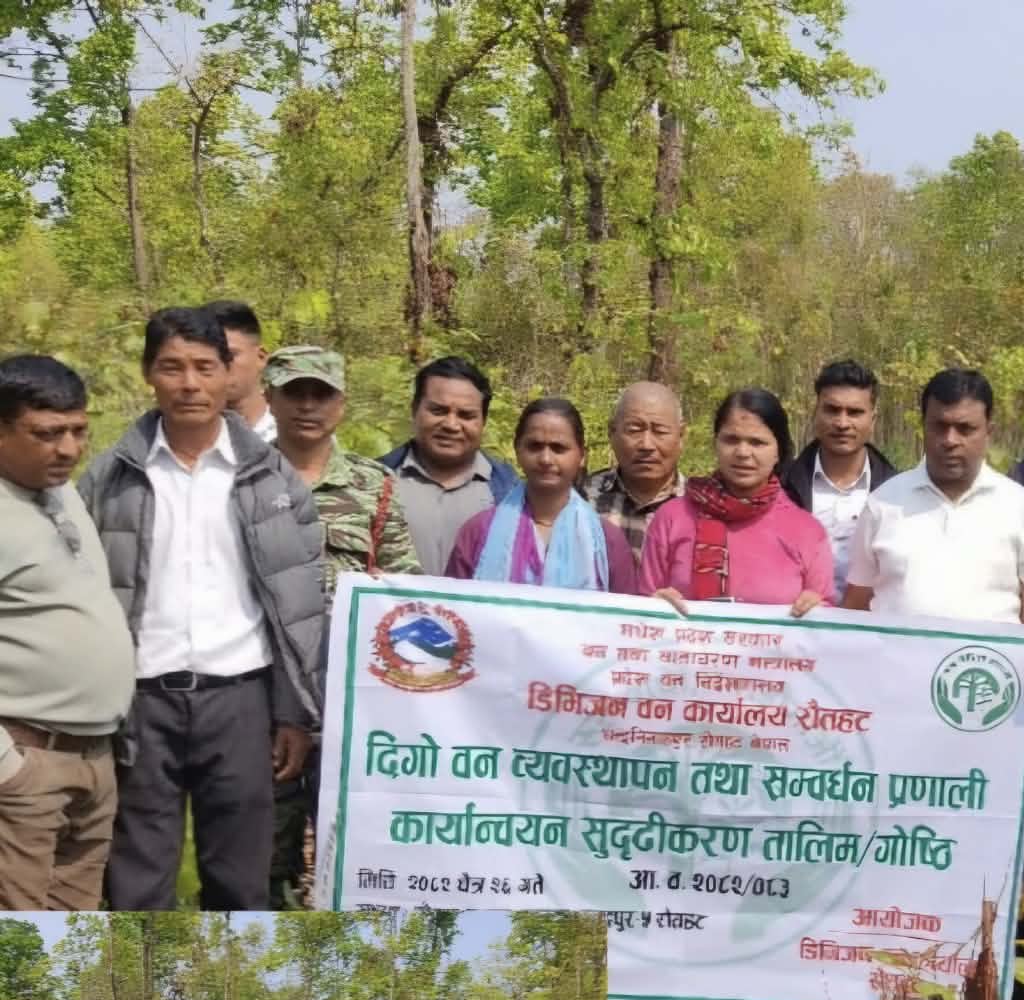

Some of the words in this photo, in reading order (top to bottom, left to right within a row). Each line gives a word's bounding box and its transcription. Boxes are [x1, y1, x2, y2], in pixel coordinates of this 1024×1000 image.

[636, 699, 673, 721] वन
[683, 697, 787, 728] कार्यालय
[795, 699, 872, 733] रौतहट
[365, 730, 442, 779] दिगो
[451, 746, 503, 779] वन
[511, 748, 679, 792] व्यवस्थापन
[691, 762, 752, 797] तथा
[762, 761, 879, 804] सम्वर्धन
[888, 768, 990, 810] प्रणाली
[390, 802, 571, 847] कार्यान्वयन
[581, 811, 753, 861] सुदृढीकरण
[692, 873, 791, 898] २०८२/०८३
[851, 906, 942, 933] आयोजक
